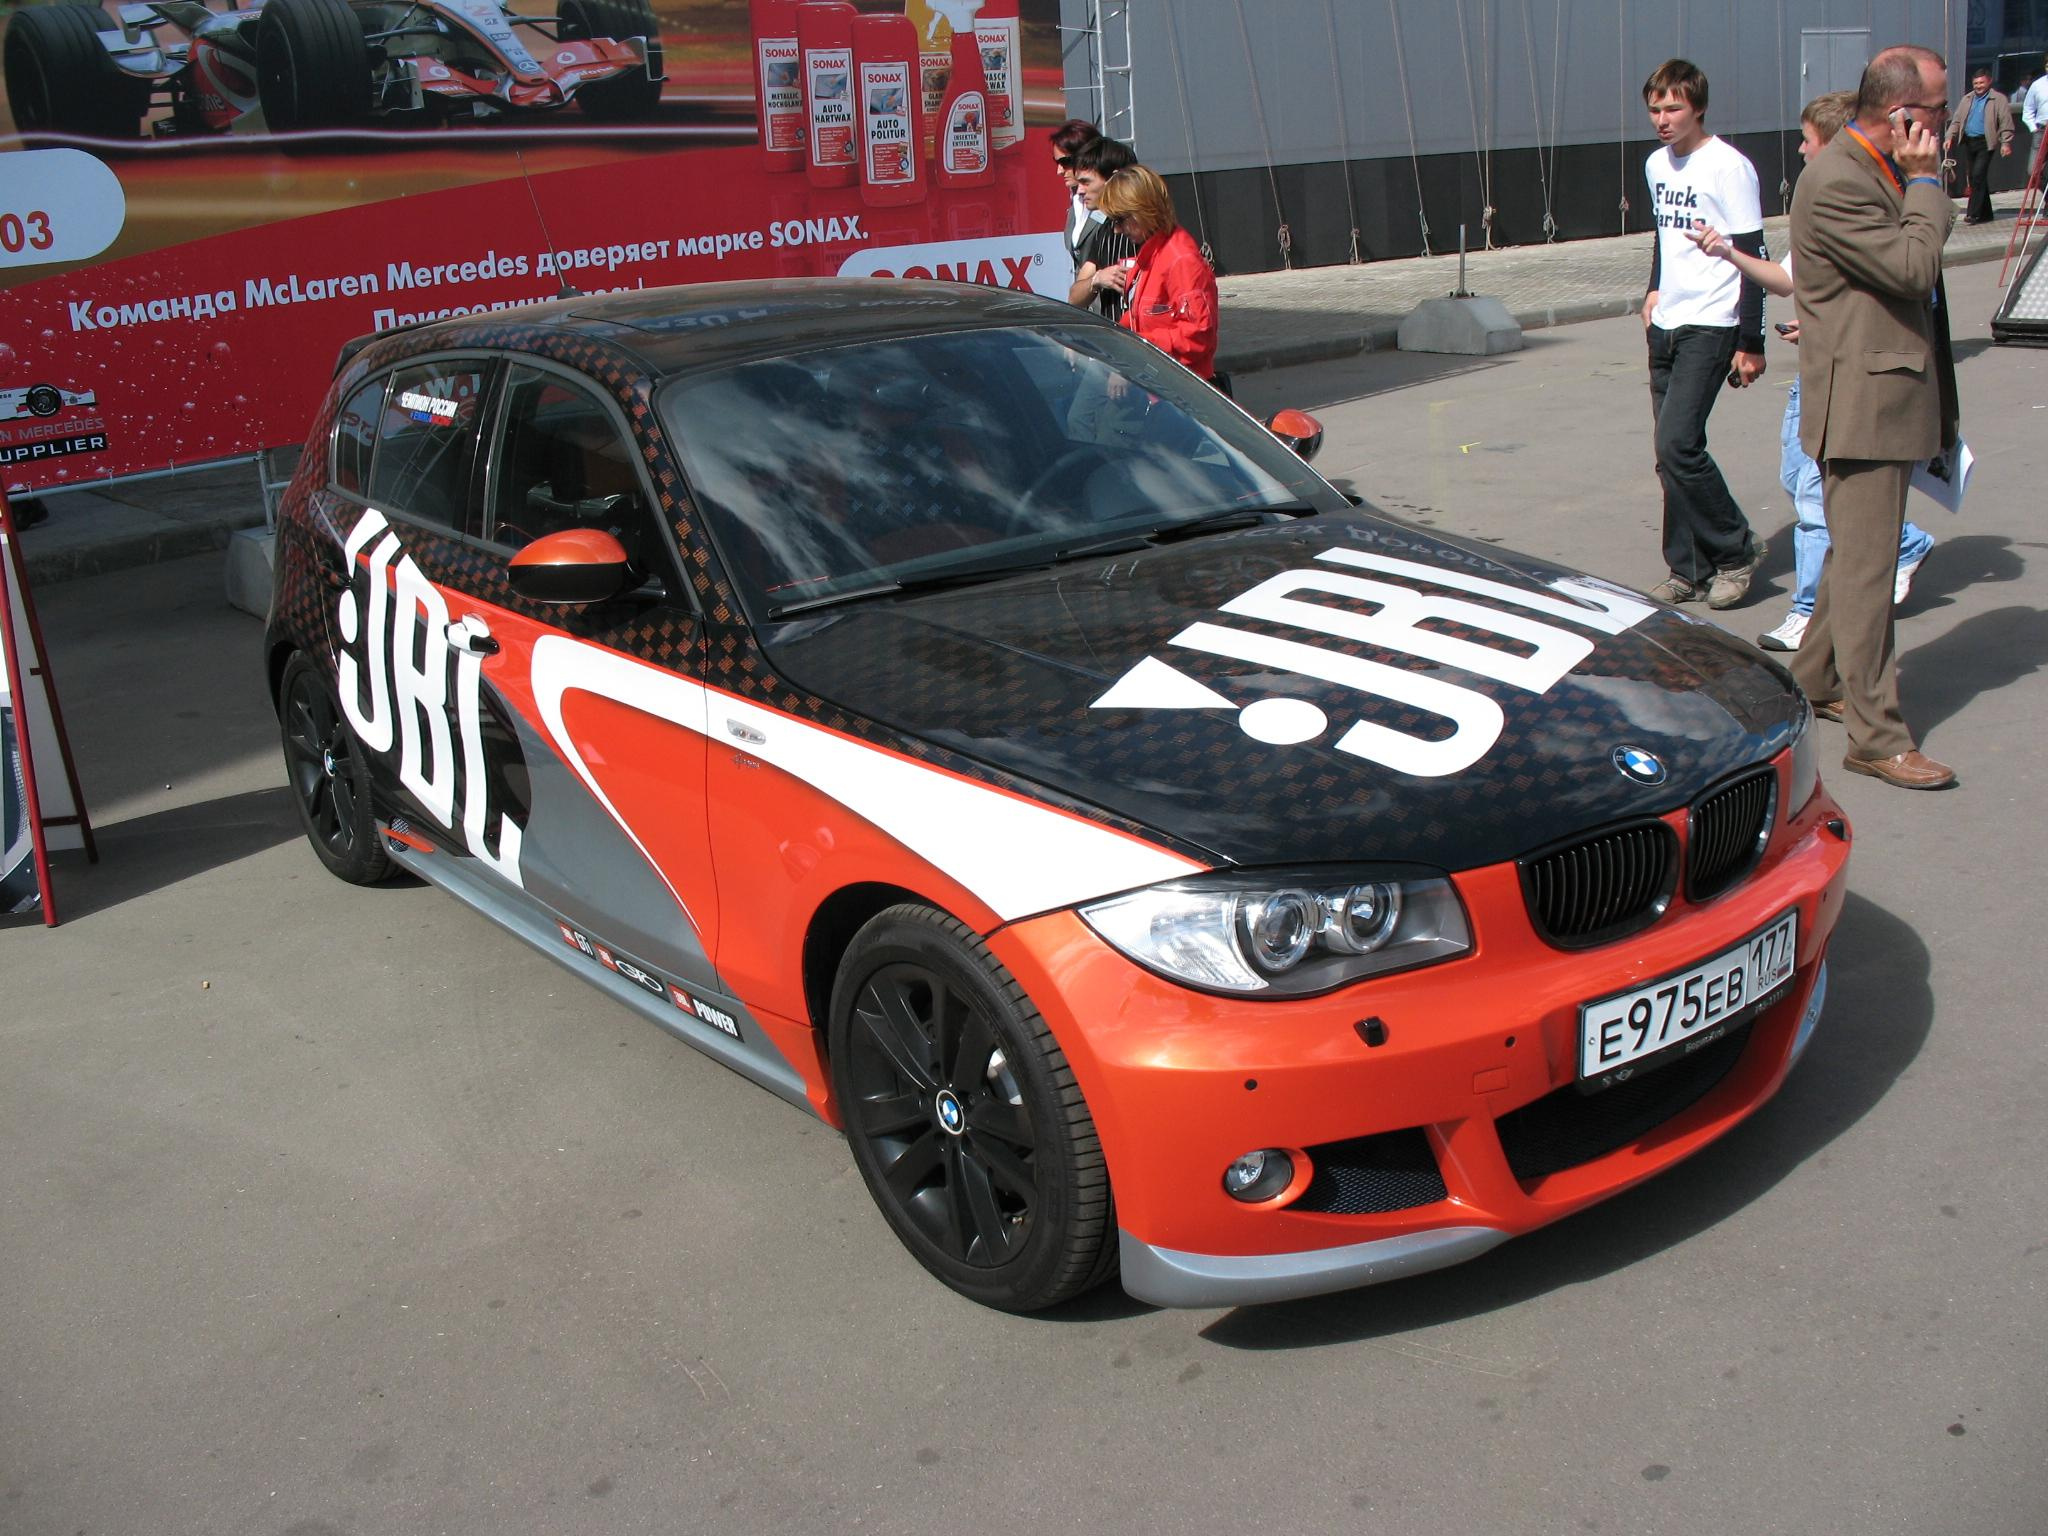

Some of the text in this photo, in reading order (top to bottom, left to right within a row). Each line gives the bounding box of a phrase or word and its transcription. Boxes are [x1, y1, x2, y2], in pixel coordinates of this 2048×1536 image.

[978, 34, 1006, 43] SONAX
[765, 48, 797, 57] SONAX
[921, 58, 949, 67] SONAX
[813, 60, 845, 69] SONAX
[868, 73, 902, 83] SONAX
[815, 114, 851, 123] HARTWAX
[823, 104, 843, 113] AUTO
[871, 129, 906, 139] POLITUR
[877, 120, 899, 129] AUTO
[1656, 183, 1698, 208] Fuck
[0, 210, 54, 253] 03
[68, 215, 869, 332] Команда McLaren Mercedes доверяет марке SONAX.
[18, 418, 105, 440] MERCEDES
[1168, 547, 1658, 777] JBL
[339, 508, 524, 889] JBL
[574, 931, 594, 956] GTi
[1752, 921, 1790, 977] 177
[1757, 968, 1778, 992] RUS
[692, 998, 739, 1037] POWER
